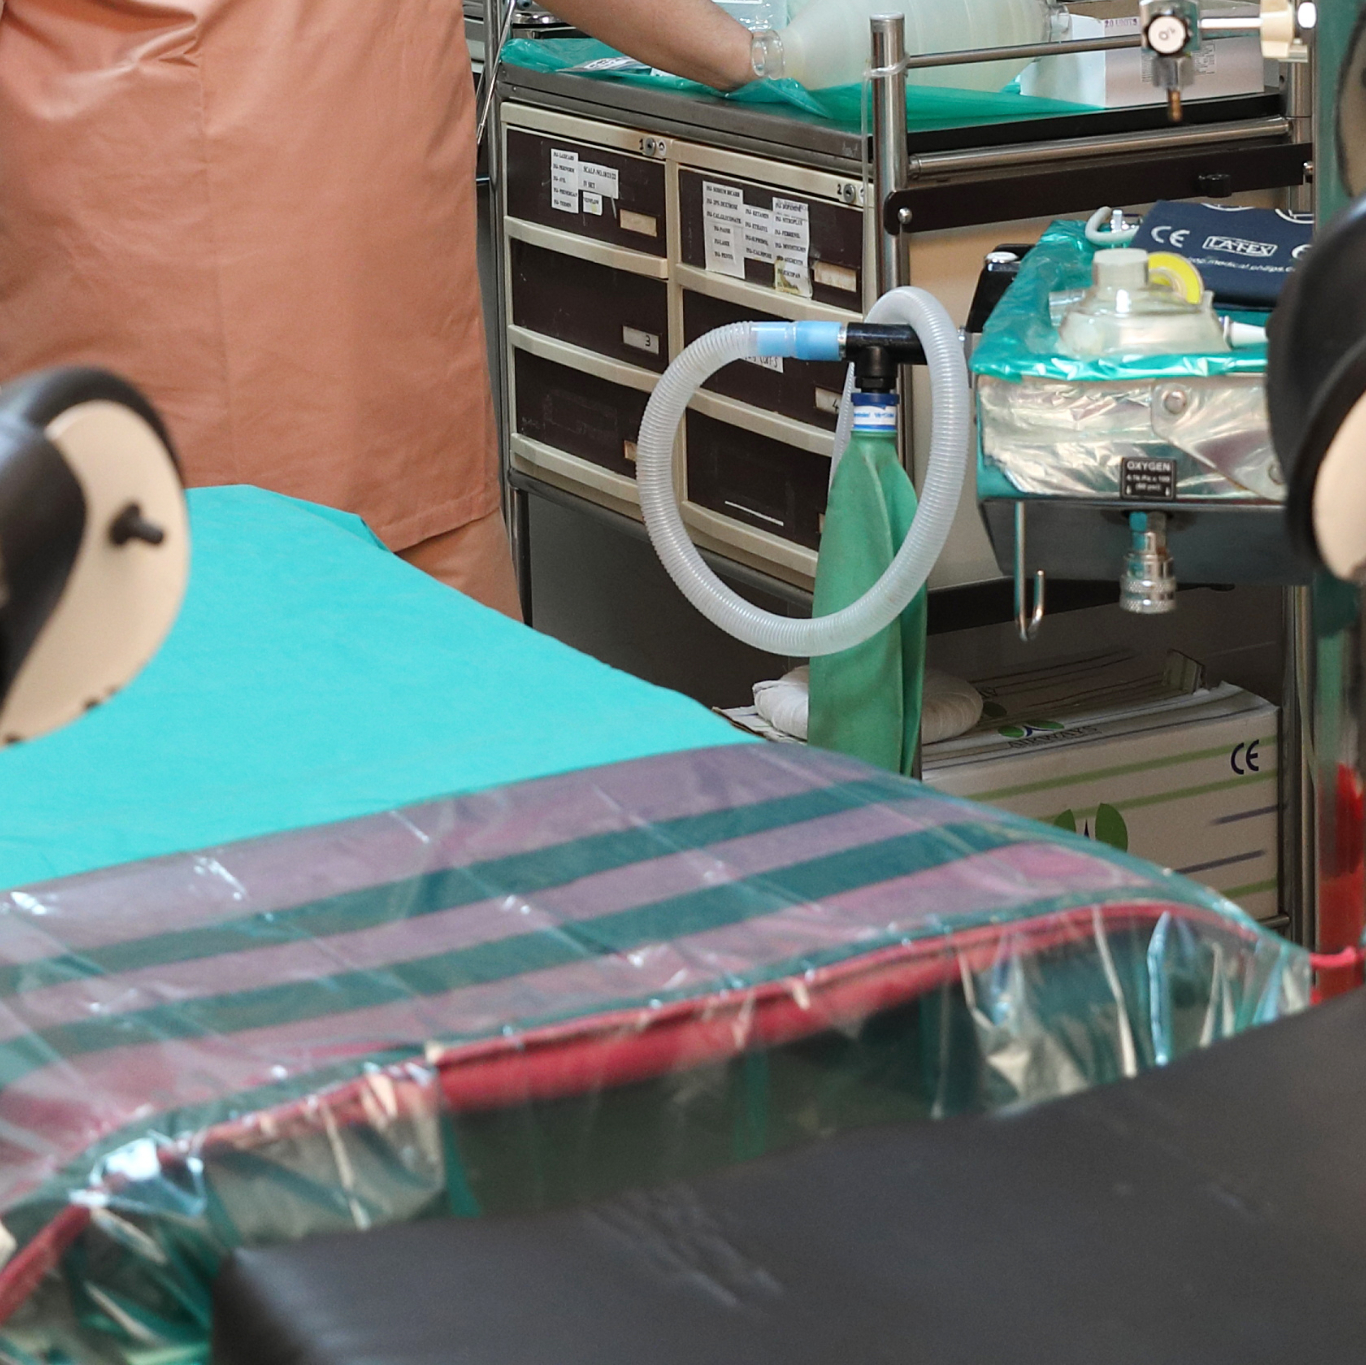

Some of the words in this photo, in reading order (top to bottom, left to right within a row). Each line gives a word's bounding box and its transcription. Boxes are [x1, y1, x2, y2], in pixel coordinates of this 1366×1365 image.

[639, 138, 644, 150] 1
[1208, 237, 1273, 256] LATEX
[645, 335, 651, 347] 3
[832, 398, 839, 409] 4
[1127, 460, 1171, 472] OXYGEN
